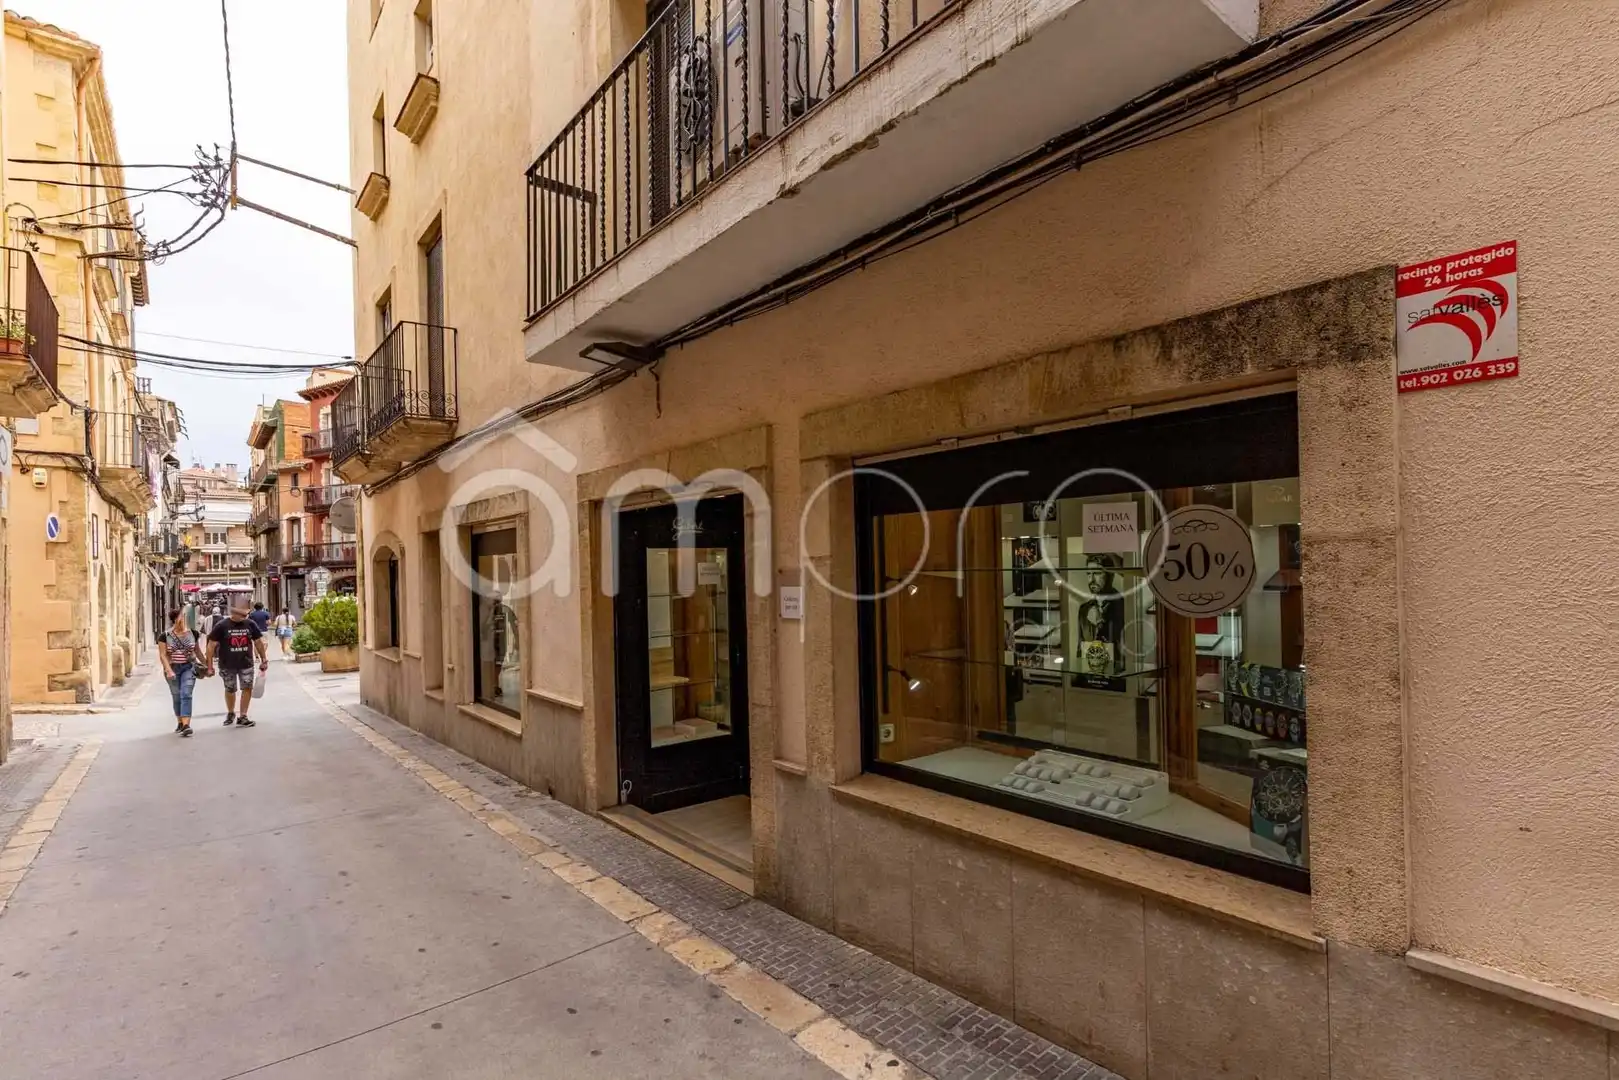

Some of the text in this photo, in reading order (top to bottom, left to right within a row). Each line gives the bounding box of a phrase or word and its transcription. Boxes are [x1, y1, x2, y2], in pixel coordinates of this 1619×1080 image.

[1397, 246, 1515, 282] recinto protegido
[1424, 266, 1484, 288] 24 horas
[1400, 361, 1516, 389] tel.902 026 339
[1087, 524, 1134, 533] SETMANA
[1162, 542, 1245, 582] 50%
